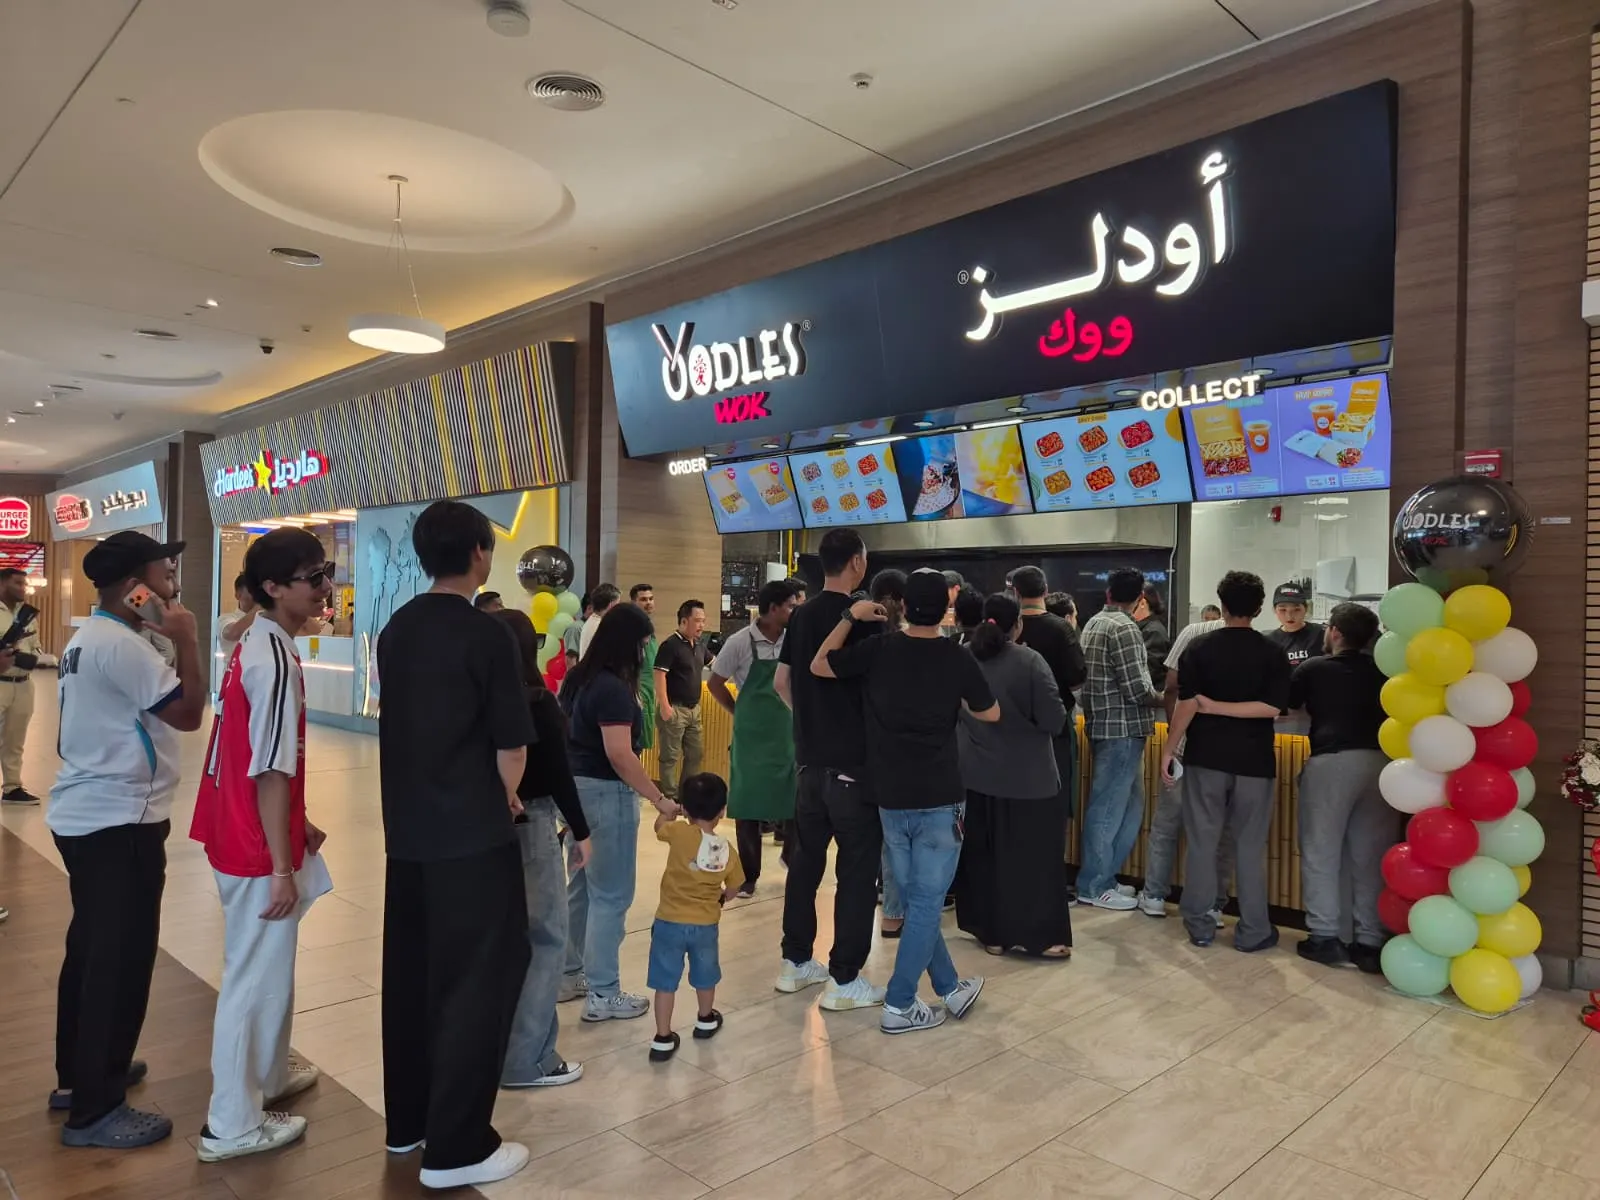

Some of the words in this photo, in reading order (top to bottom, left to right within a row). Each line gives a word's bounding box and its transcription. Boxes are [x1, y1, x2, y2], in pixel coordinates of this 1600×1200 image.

[1039, 307, 1133, 362] ووك
[1140, 375, 1261, 412] COLLECT
[713, 391, 768, 425] WOK
[668, 457, 708, 476] ORDER
[0, 511, 28, 519] URGER
[1288, 650, 1309, 660] DLES
